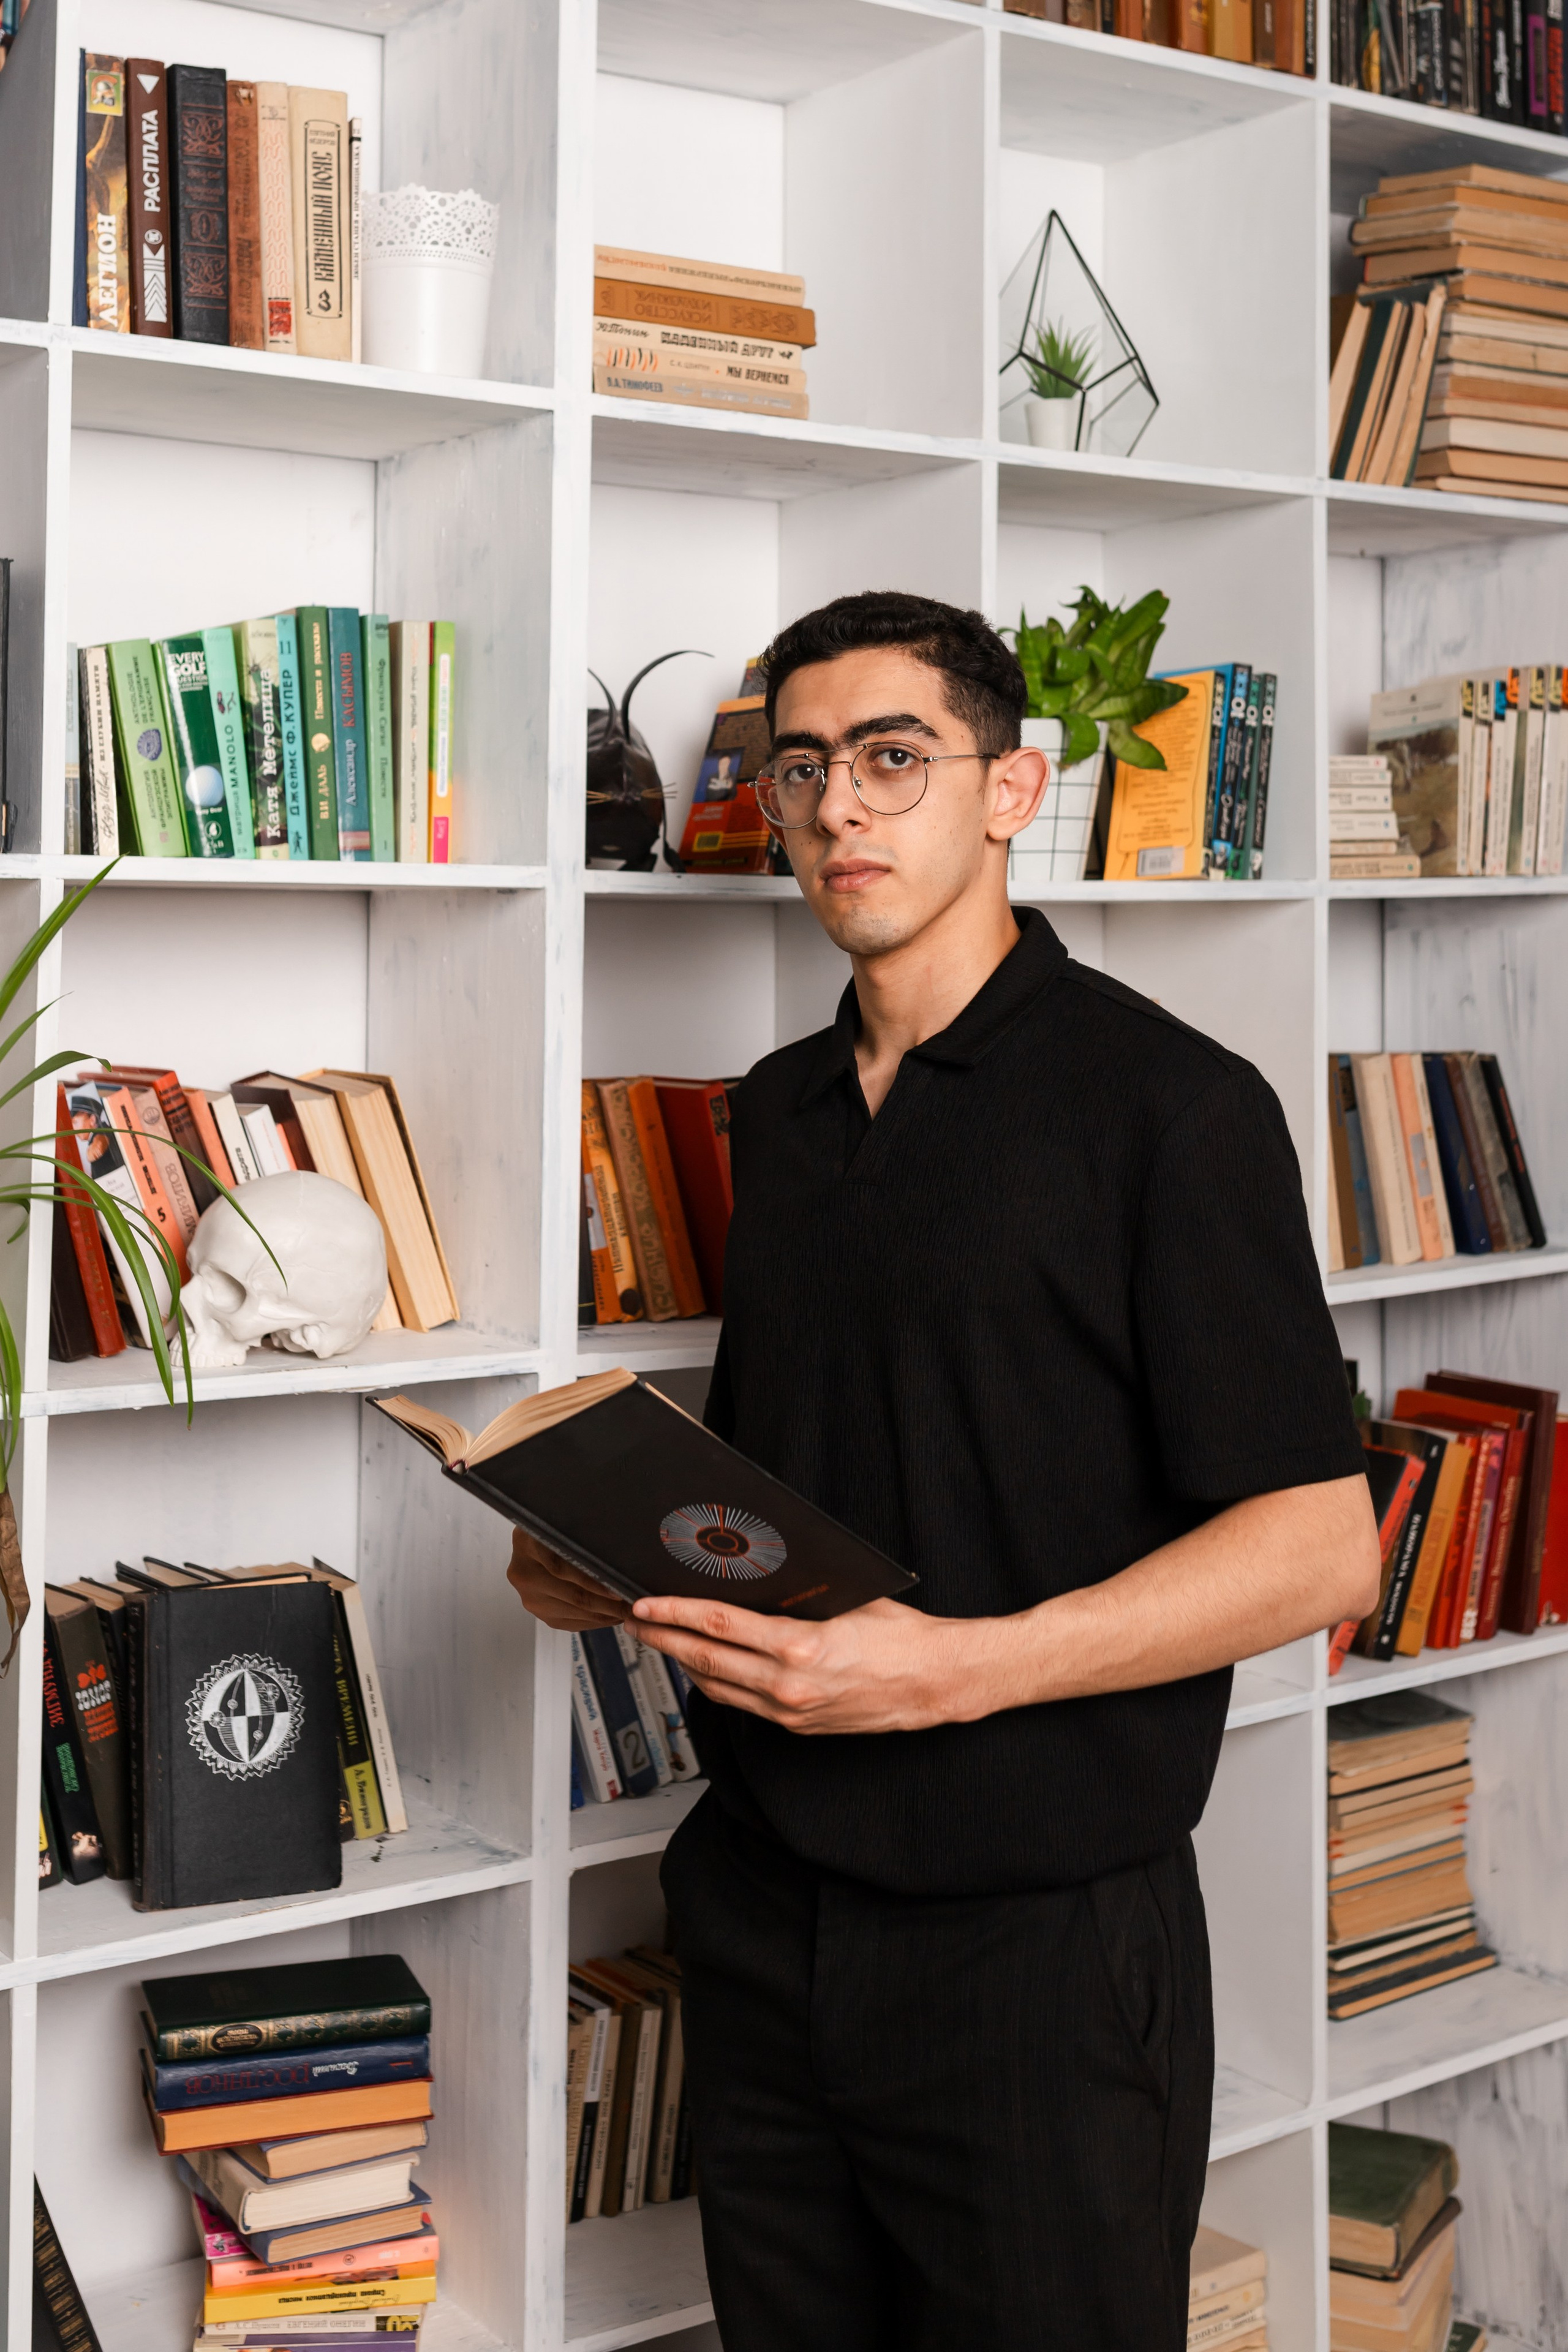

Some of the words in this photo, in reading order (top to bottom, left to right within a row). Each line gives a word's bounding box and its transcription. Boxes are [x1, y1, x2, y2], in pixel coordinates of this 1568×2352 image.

[143, 109, 160, 213] РАСПЛАТА
[311, 150, 333, 192] ПОЯС
[311, 195, 334, 282] КАМЕННЫЙ
[98, 214, 118, 329] ЛЕГИОН
[168, 652, 205, 666] EVERY
[173, 663, 206, 677] GOLF
[175, 674, 208, 684] UESTION
[340, 652, 355, 728] КАСЫМОВ
[262, 668, 277, 775] Метелица
[225, 724, 239, 788] MANOLO
[290, 747, 301, 816] Джеймс
[318, 763, 329, 796] ДАЛЬ
[345, 739, 357, 807] Александр
[266, 786, 281, 837] Катя
[157, 1206, 166, 1223] 5
[43, 1657, 64, 1728] ЗИГМУНД
[336, 1678, 357, 1746] ВРЕМЕНИ
[622, 1733, 645, 1770] 2
[186, 2062, 309, 2095] РОСЛЯКОВ
